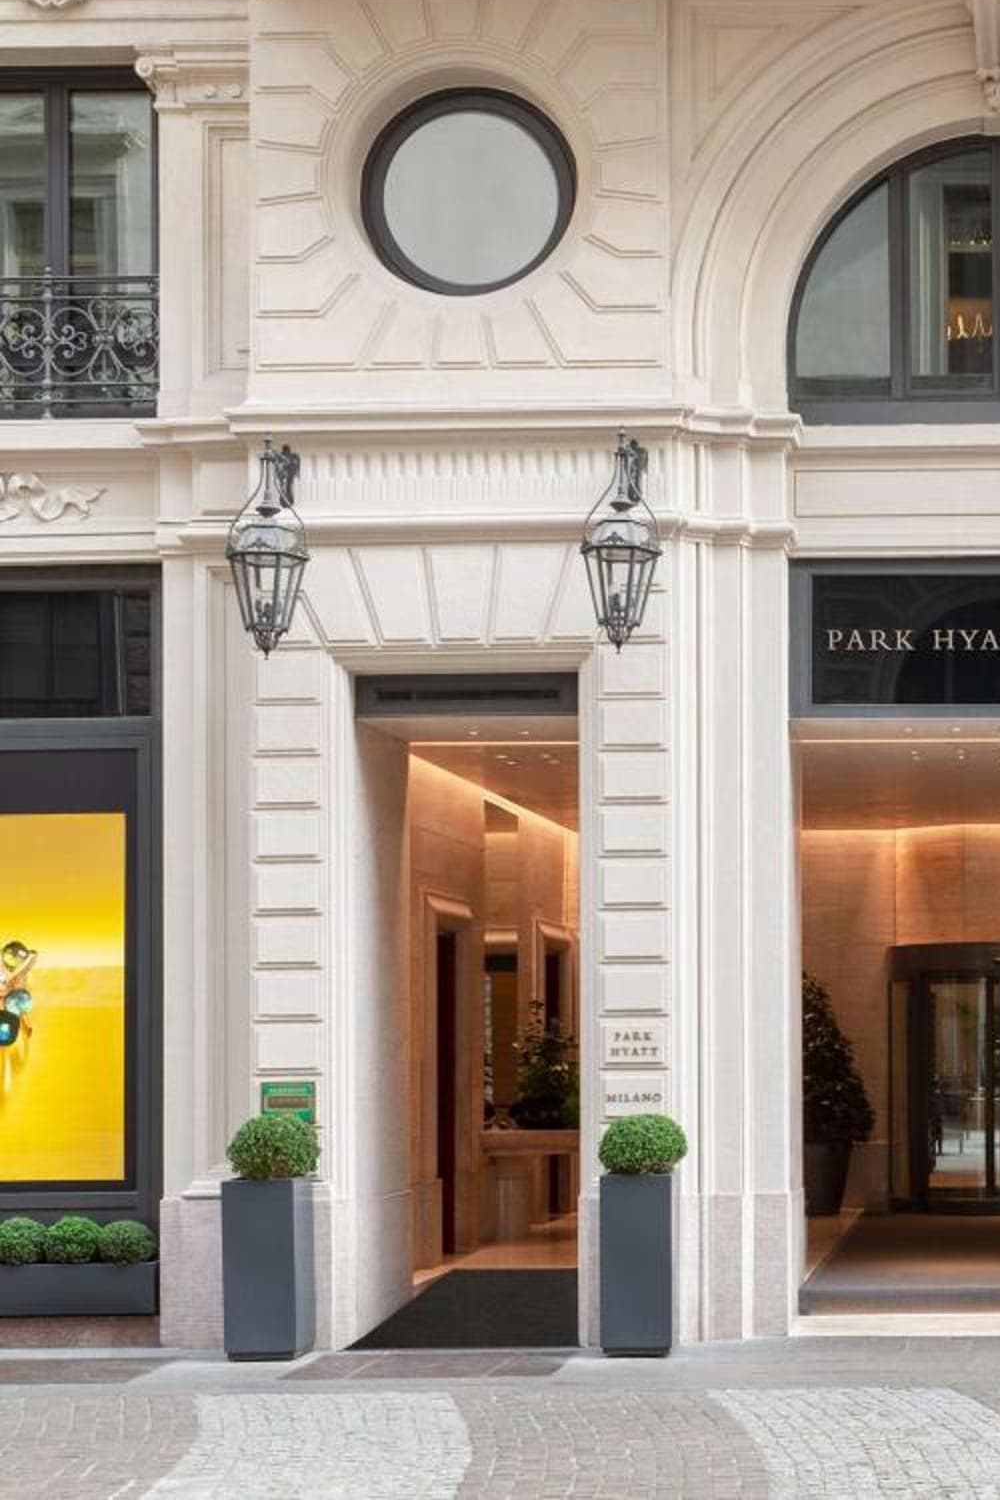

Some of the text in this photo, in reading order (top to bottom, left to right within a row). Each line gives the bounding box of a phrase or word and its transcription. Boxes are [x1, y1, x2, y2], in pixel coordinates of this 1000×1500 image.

[827, 629, 915, 651] PARK
[614, 1031, 653, 1041] PARK
[610, 1047, 658, 1057] HYATT
[607, 1093, 662, 1103] MILANO
